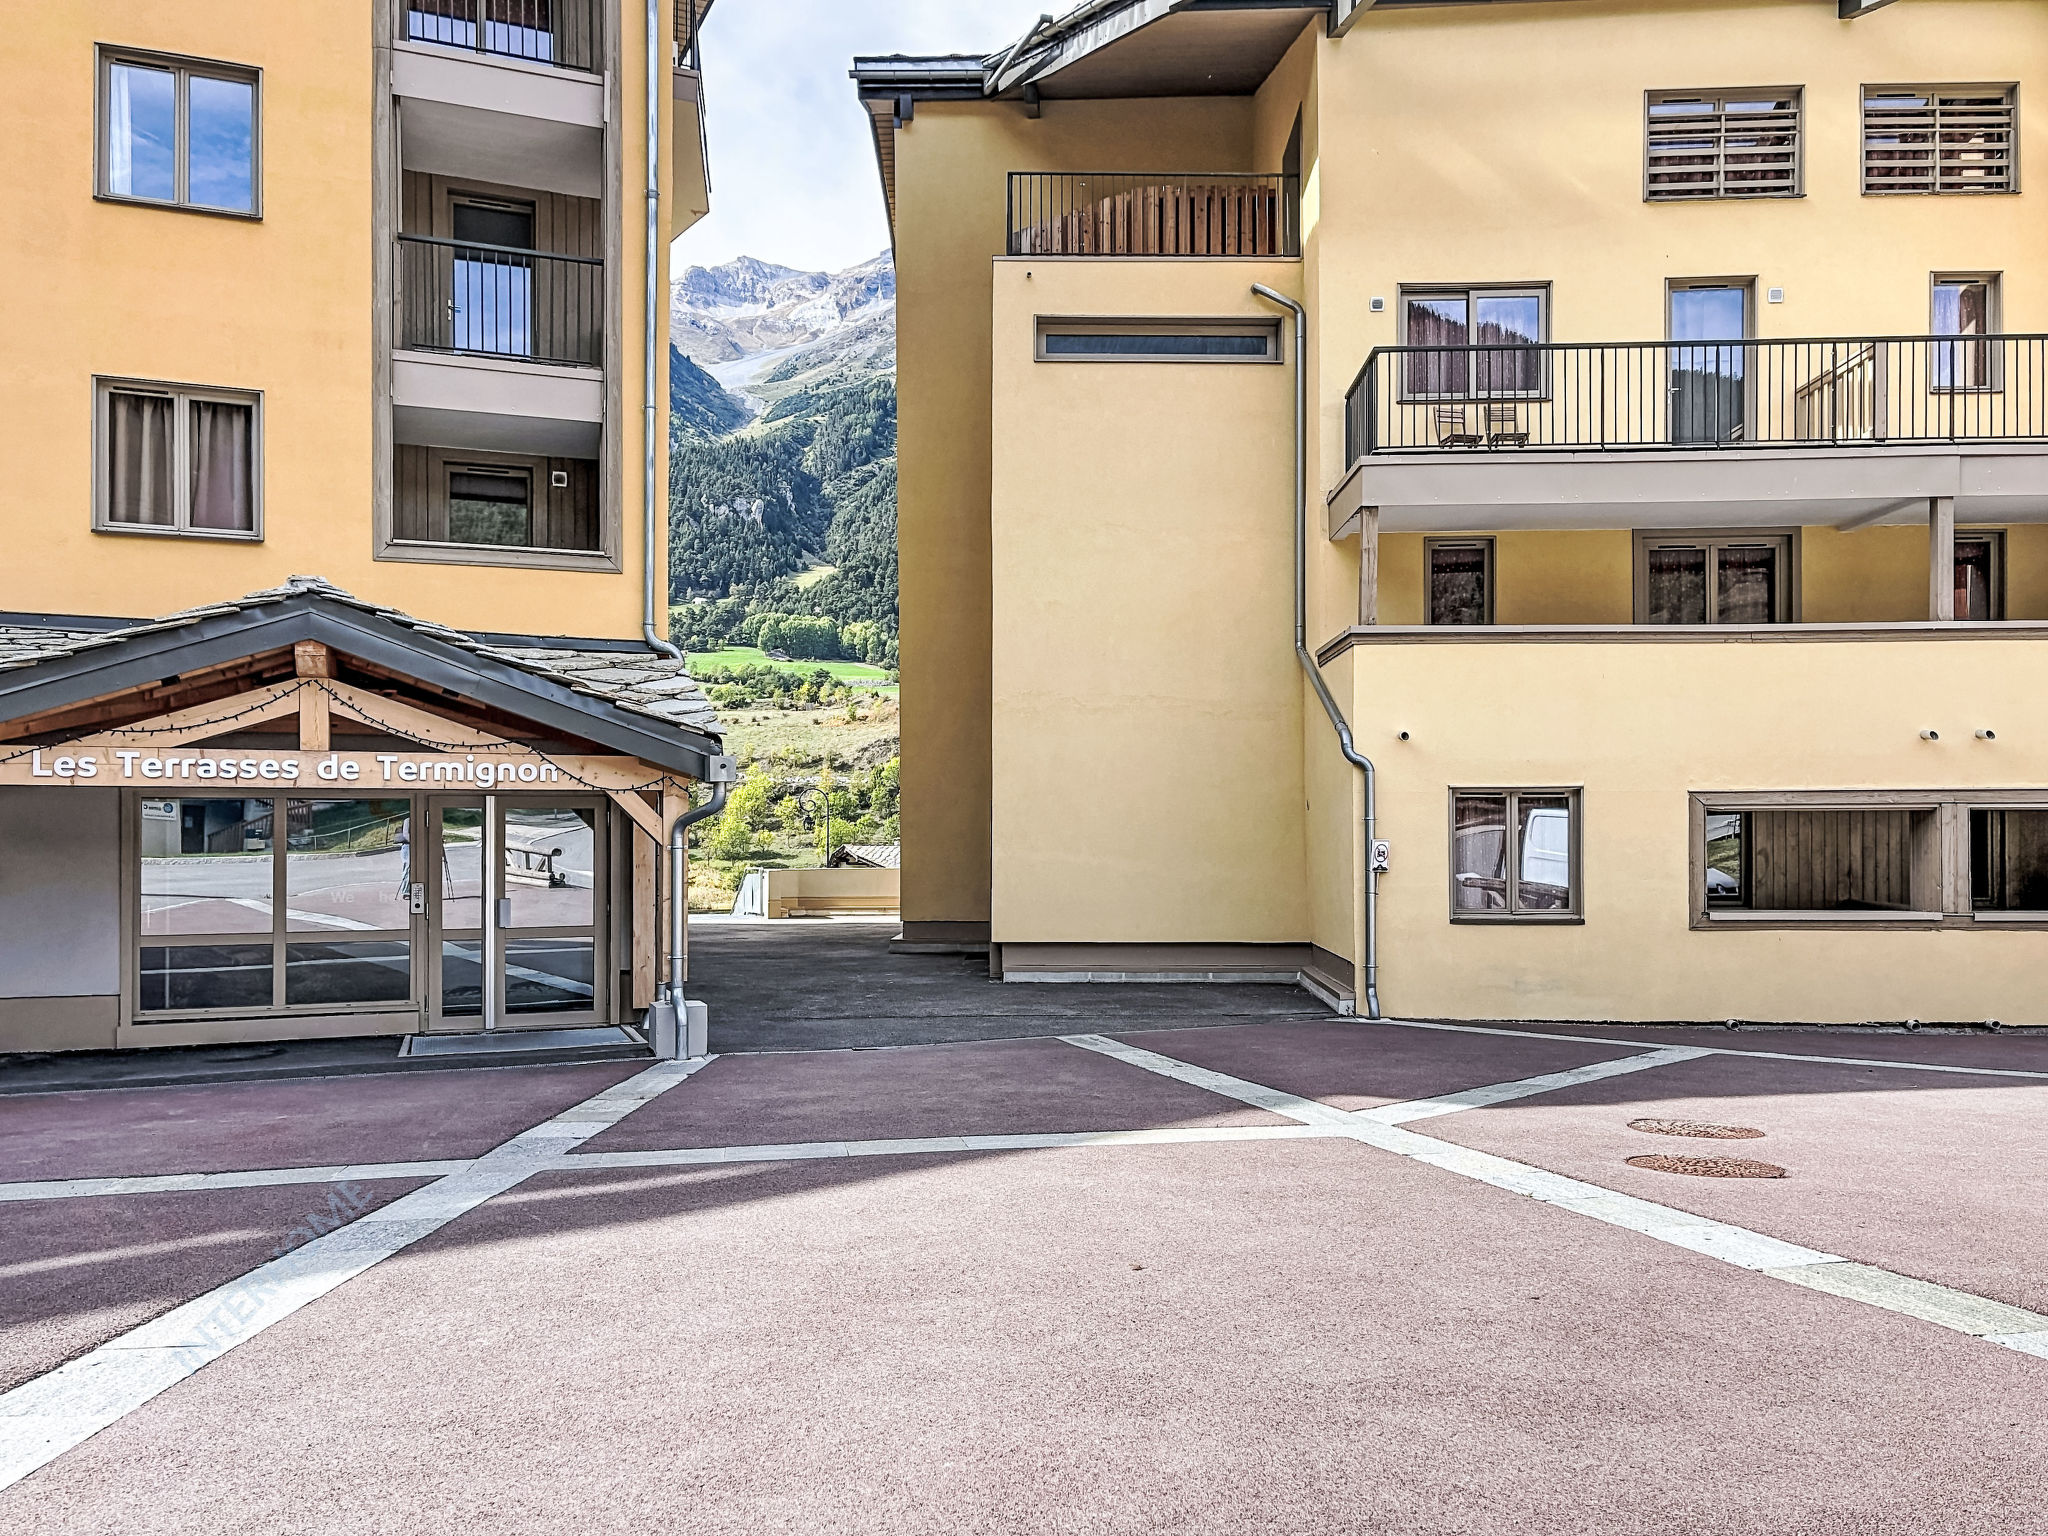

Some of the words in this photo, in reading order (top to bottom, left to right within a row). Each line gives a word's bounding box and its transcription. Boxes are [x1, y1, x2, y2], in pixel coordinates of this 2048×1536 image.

[31, 749, 98, 778] Les
[115, 751, 300, 780] Terrasses
[316, 753, 361, 781] de
[375, 754, 559, 788] Termignon
